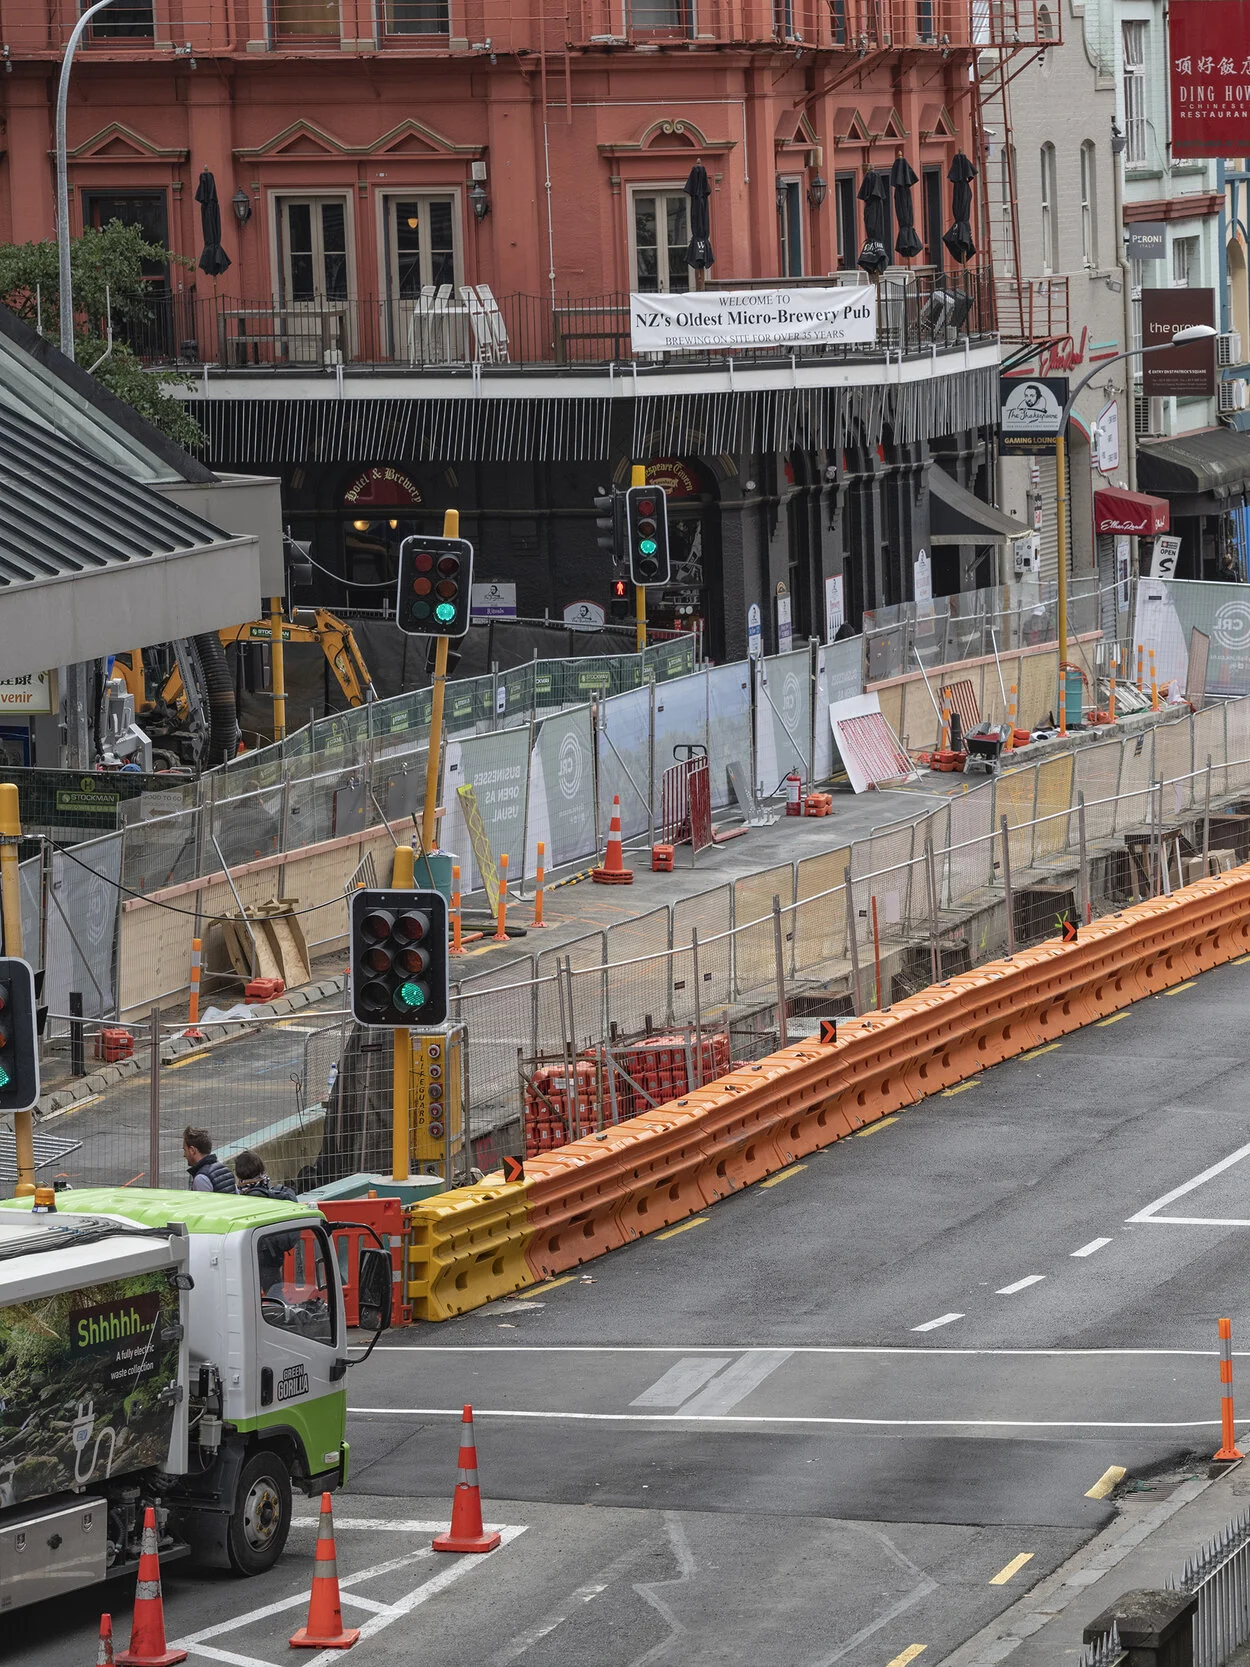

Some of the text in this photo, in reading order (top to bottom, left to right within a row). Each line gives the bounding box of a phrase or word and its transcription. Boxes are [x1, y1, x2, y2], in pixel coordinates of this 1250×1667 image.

[1180, 86, 1215, 102] DING
[1132, 235, 1162, 243] PERONI
[719, 294, 790, 306] WELCOME TO
[636, 304, 871, 328] NZ's Oldest Micro-Brewery Pub
[1149, 322, 1170, 333] the
[665, 329, 845, 346] BREWING ON SITE FOR OVER 35 YEARS
[672, 461, 693, 491] Tavern
[344, 467, 422, 503] Hotel & Brewery
[1160, 548, 1176, 556] OPEN
[70, 793, 115, 802] STOCKMAN
[77, 1306, 155, 1348] Shhhhh...
[115, 1342, 155, 1362] A fully electric
[110, 1361, 154, 1380] waste collection
[283, 1364, 304, 1381] GREEN
[277, 1373, 310, 1402] GORILLA
